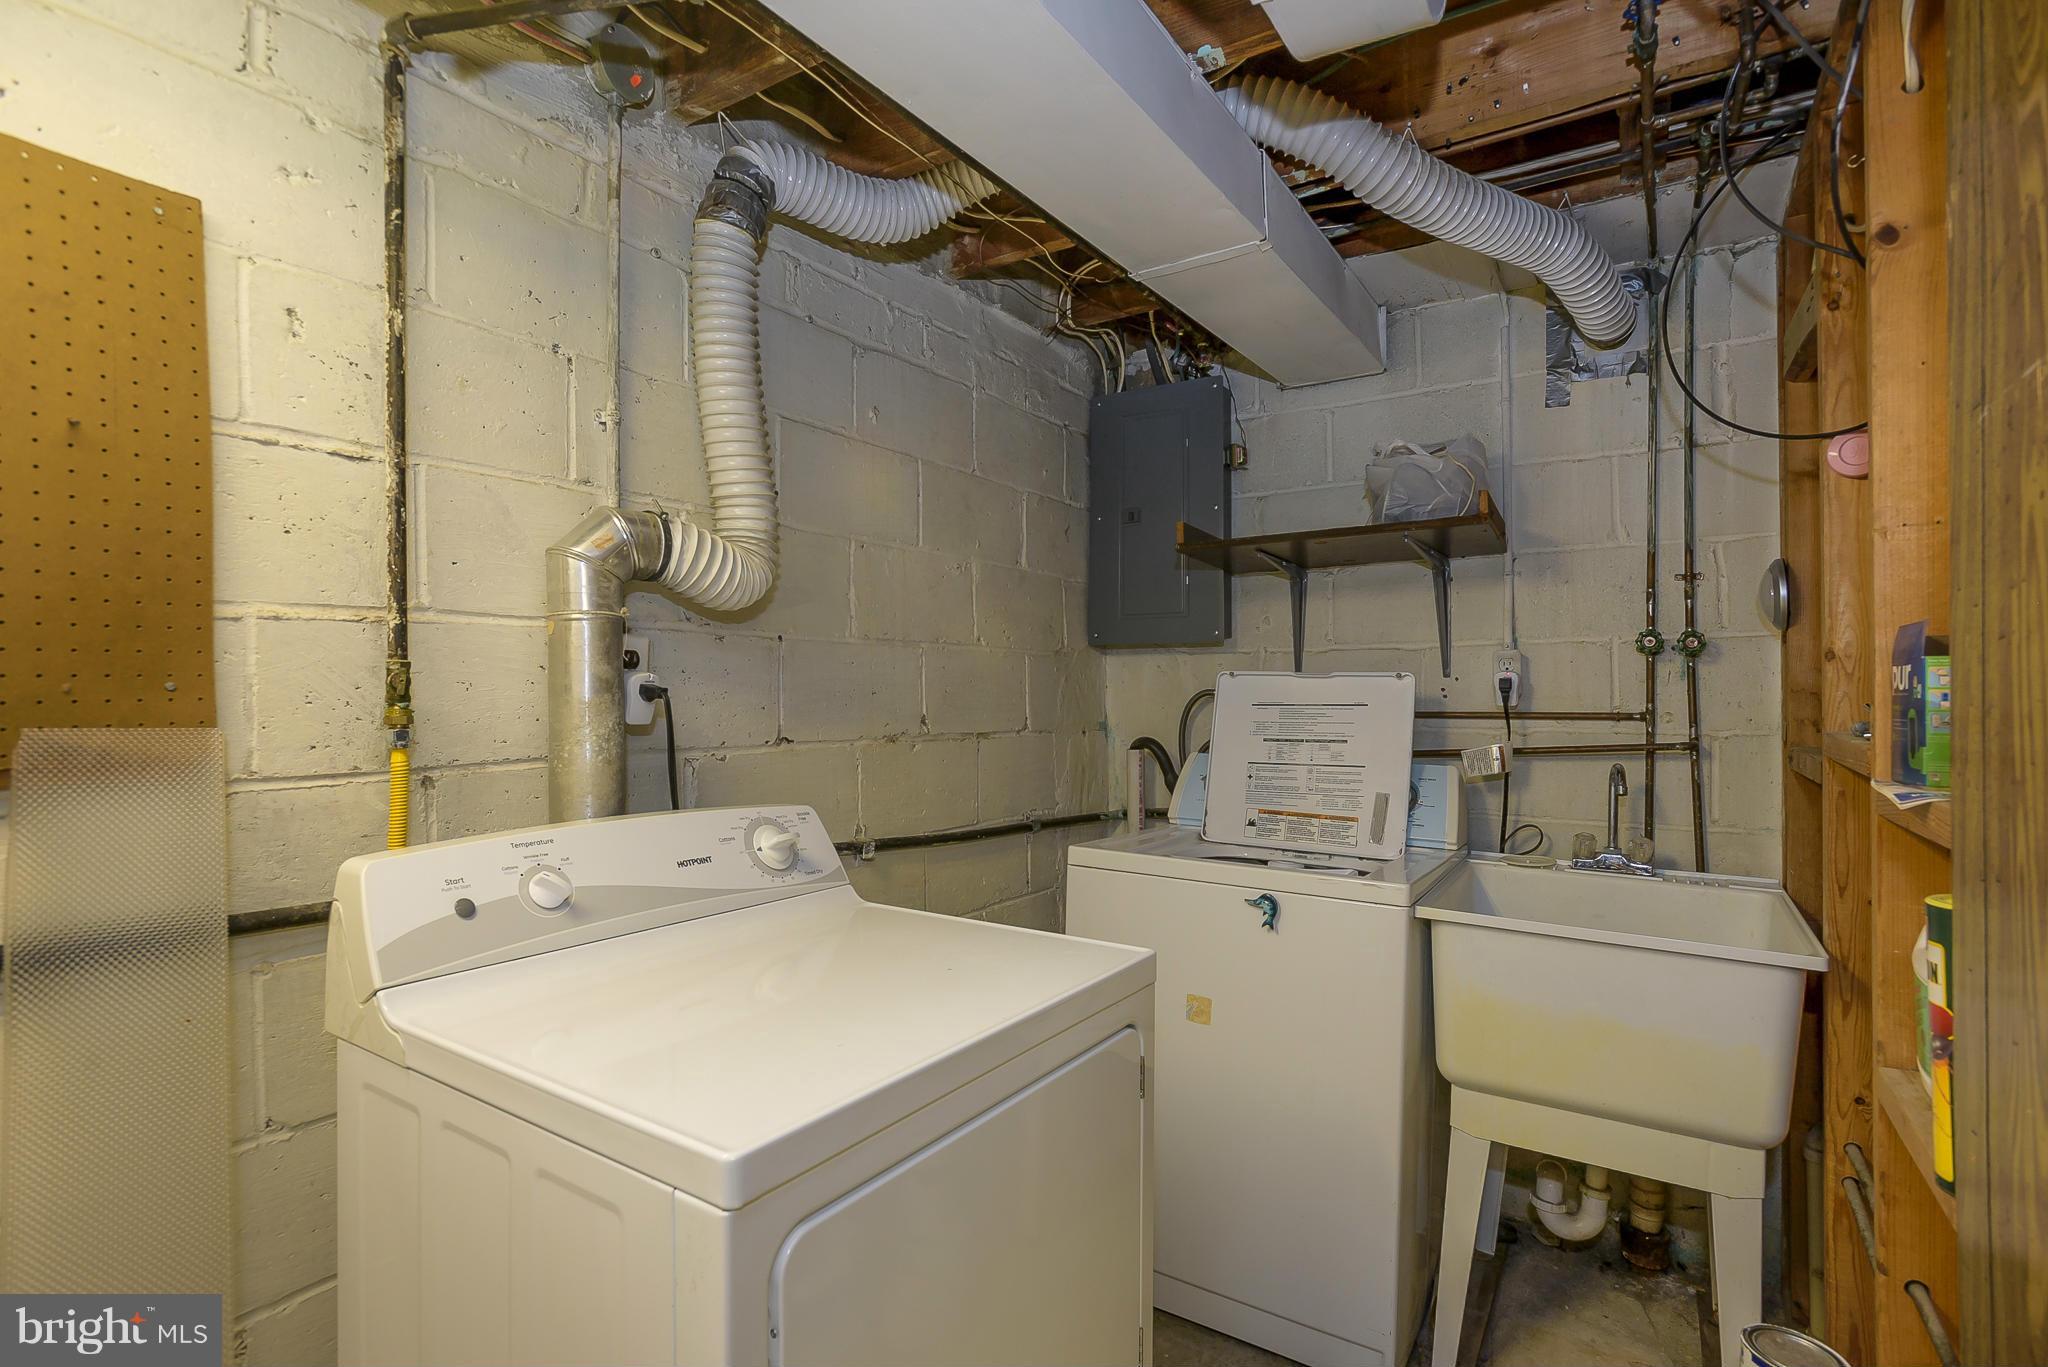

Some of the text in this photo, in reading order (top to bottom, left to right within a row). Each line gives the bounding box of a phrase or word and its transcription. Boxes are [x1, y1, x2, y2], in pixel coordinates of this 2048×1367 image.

[510, 838, 554, 849] Temperature
[677, 855, 713, 868] HOTPOINT
[444, 877, 465, 886] Start
